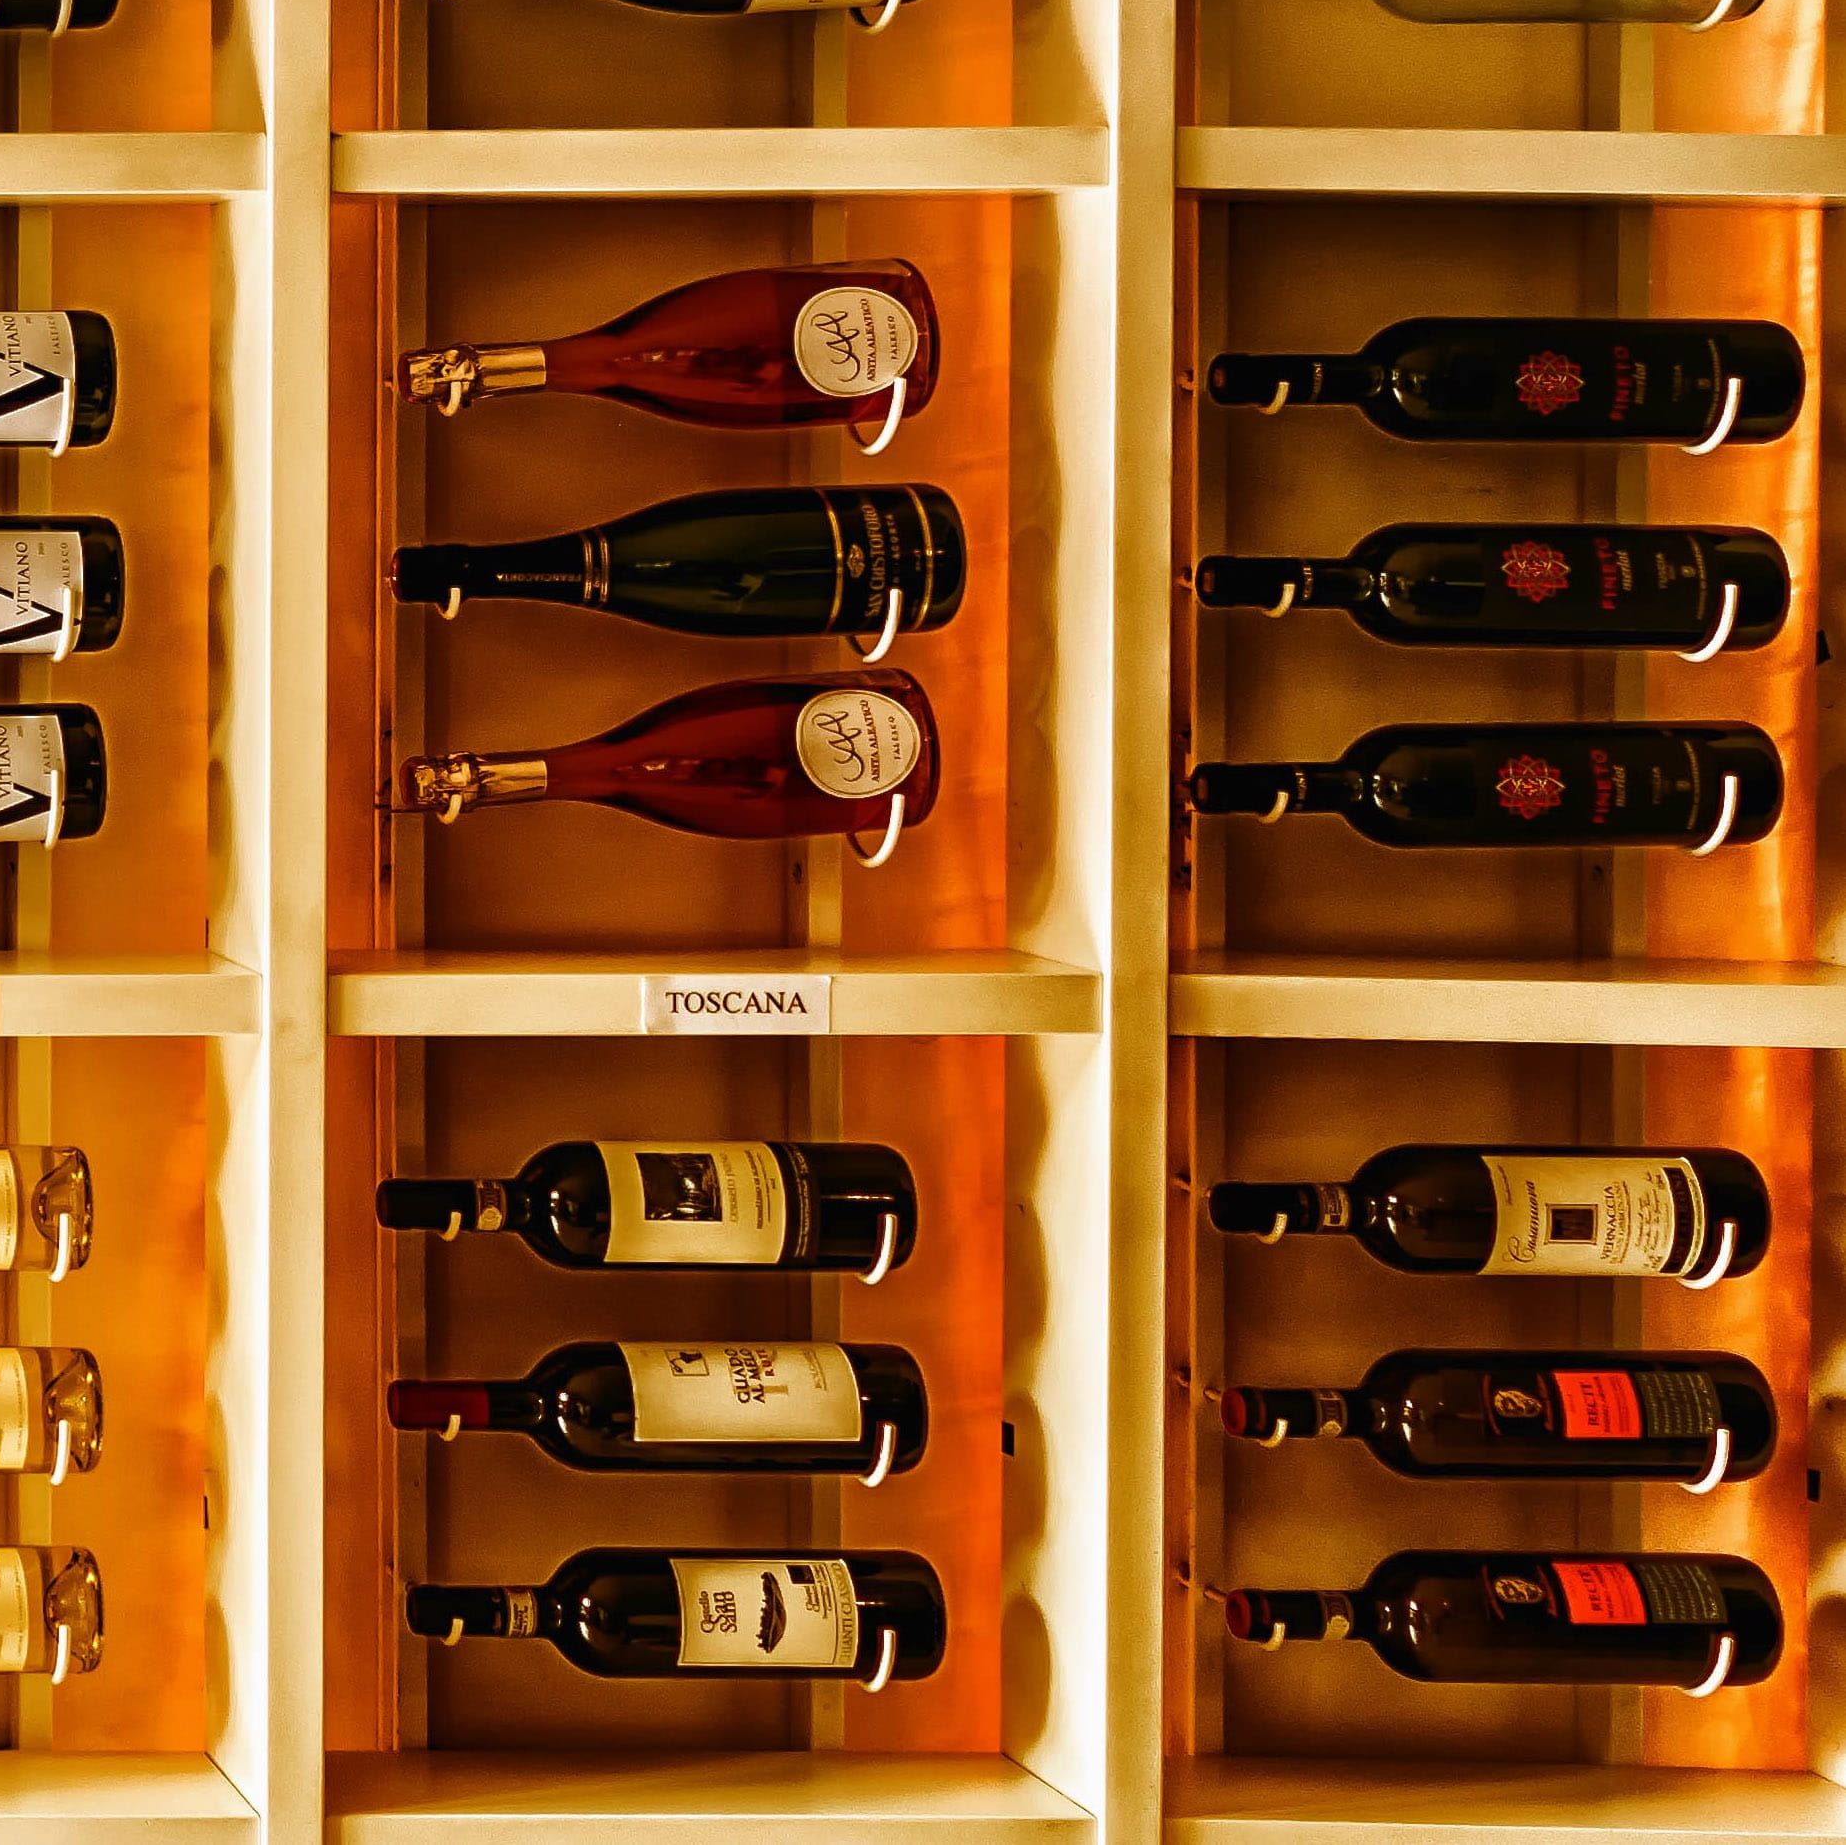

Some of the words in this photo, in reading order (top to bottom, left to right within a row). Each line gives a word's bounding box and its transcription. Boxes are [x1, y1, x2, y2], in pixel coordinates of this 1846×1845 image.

[47, 316, 61, 354] FALESCO
[859, 298, 875, 349] ALEATICO
[888, 315, 898, 360] FALESCO
[3, 316, 21, 376] VITIANO
[865, 352, 876, 381] ANITA
[1632, 363, 1647, 404] merlot
[861, 504, 886, 590] CRISTOFORO
[16, 541, 29, 615] VITIANO
[1616, 551, 1633, 591] merlot
[864, 593, 884, 617] SAN
[860, 700, 879, 749] ALEATICO
[888, 716, 901, 760] FALESCO
[40, 725, 52, 774] FALESCO
[869, 752, 881, 782] ANITA
[1613, 766, 1627, 807] merlot
[665, 992, 807, 1015] TOSCANA
[1600, 1186, 1616, 1260] VERNACCIA
[724, 1348, 750, 1404] GUADO
[741, 1348, 762, 1380] MELO
[749, 1384, 765, 1403] AL
[1578, 1381, 1600, 1426] RECIT
[710, 1593, 727, 1623] San
[1579, 1569, 1603, 1611] RECIT
[722, 1591, 737, 1633] Sano
